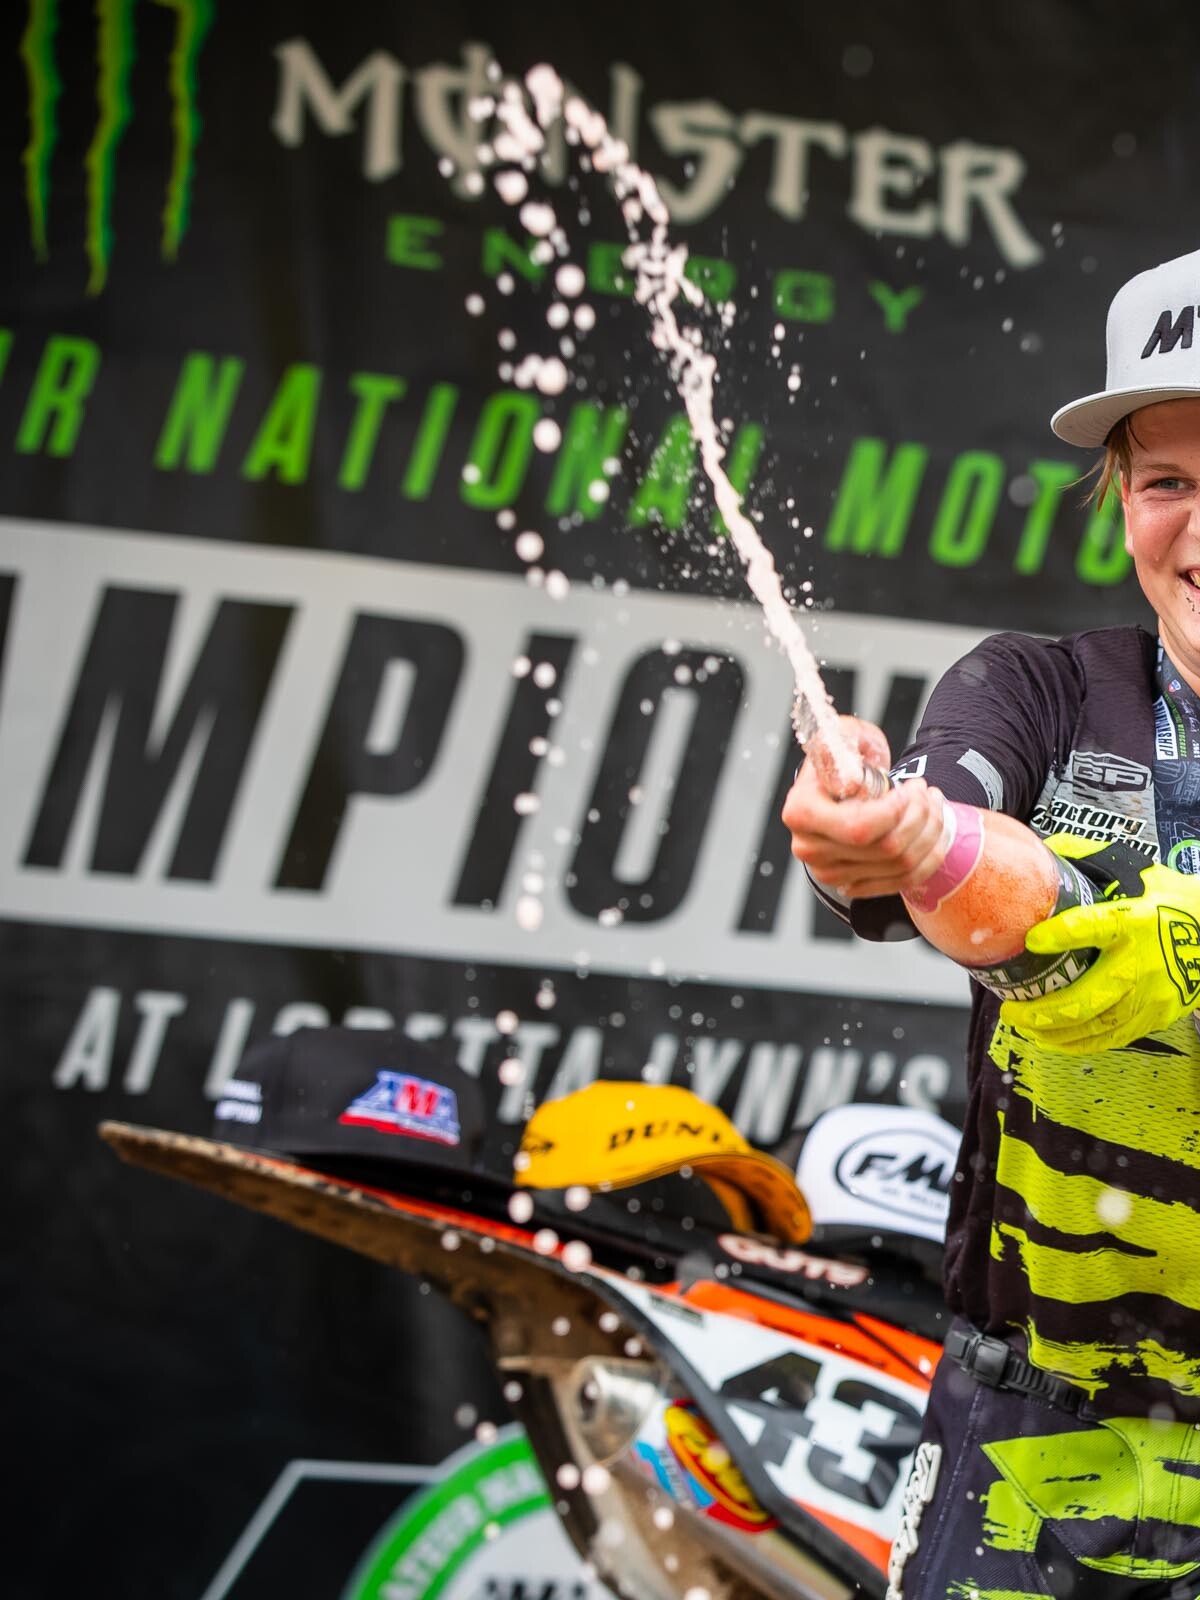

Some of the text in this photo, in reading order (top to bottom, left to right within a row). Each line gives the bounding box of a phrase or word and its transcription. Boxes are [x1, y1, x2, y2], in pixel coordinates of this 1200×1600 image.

[153, 352, 764, 534] NATIONAL
[0, 570, 928, 945] MPION
[1049, 797, 1148, 839] actory
[54, 986, 186, 1096] AT
[203, 998, 604, 1126] LTTA
[848, 1152, 950, 1194] FM
[717, 1350, 926, 1512] 43
